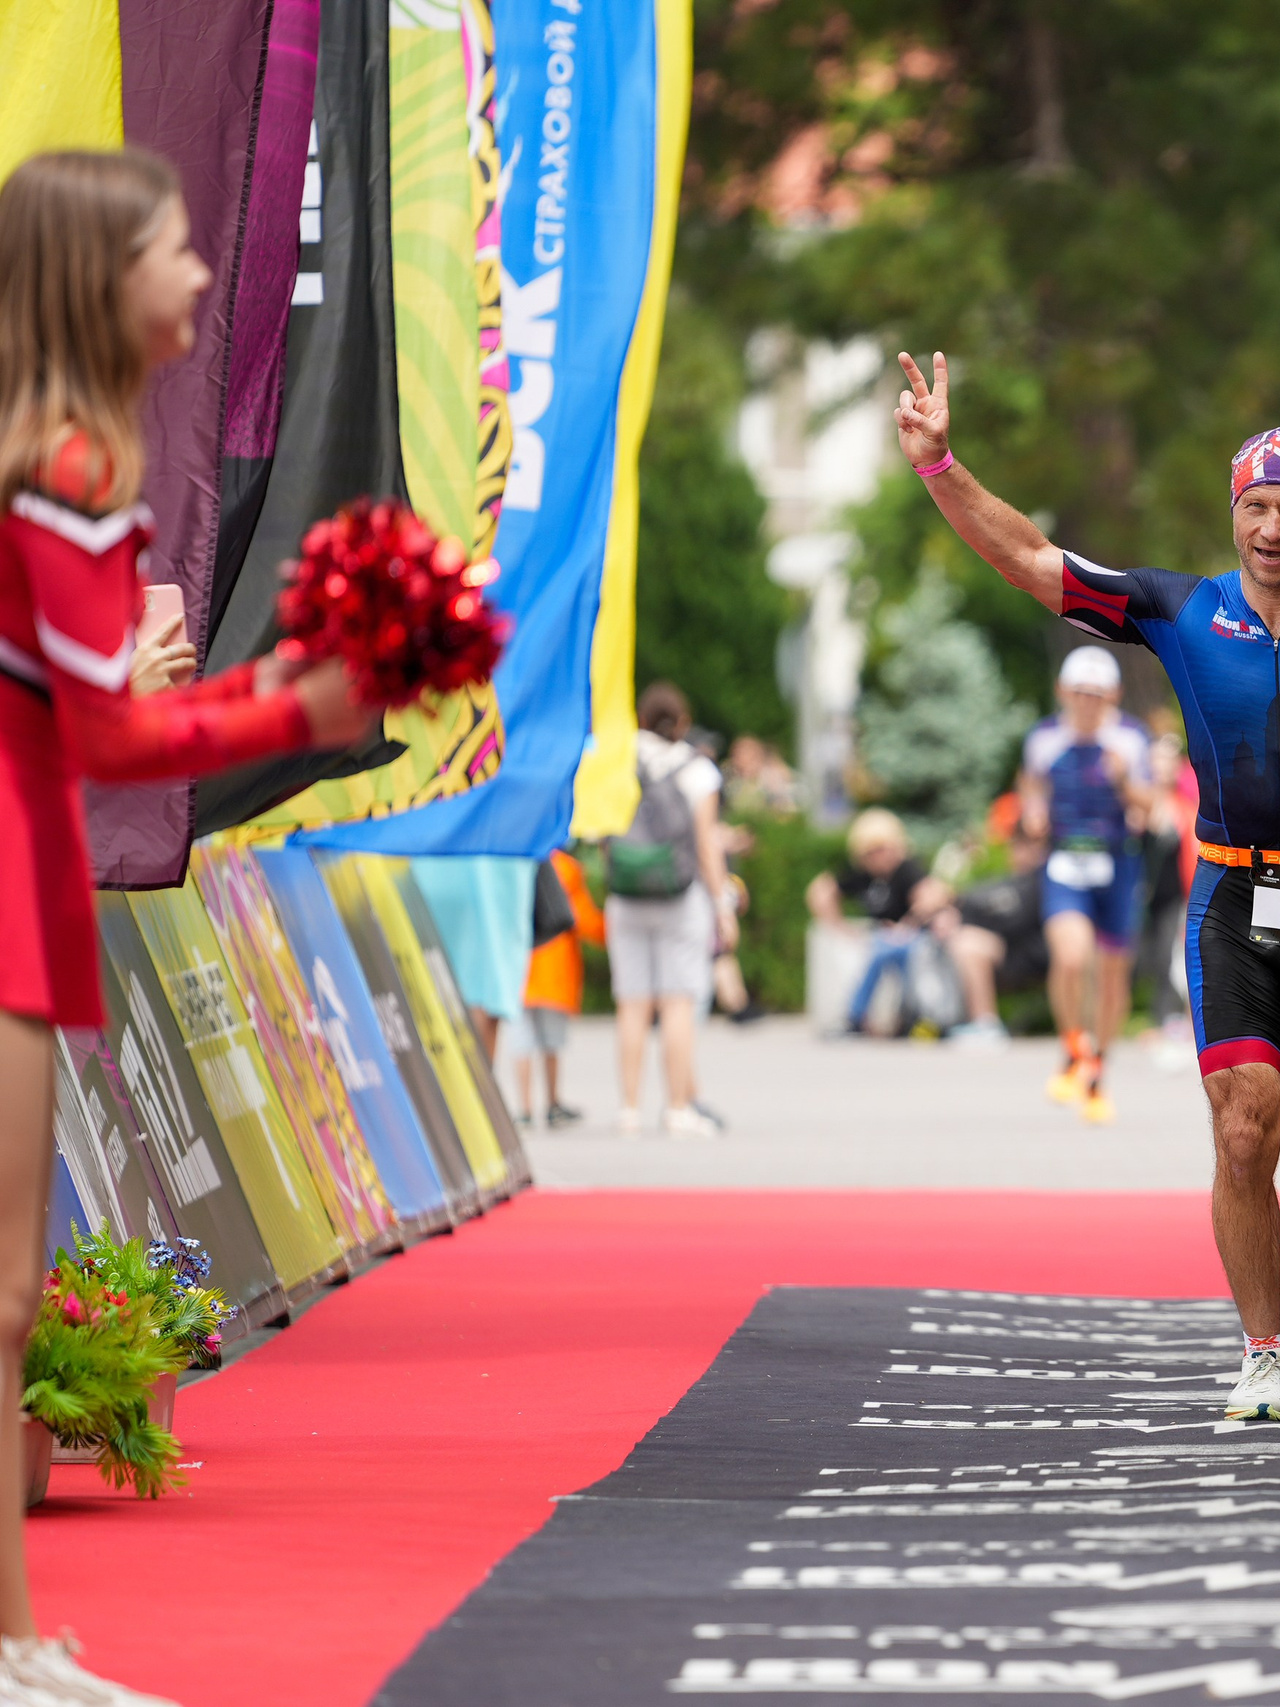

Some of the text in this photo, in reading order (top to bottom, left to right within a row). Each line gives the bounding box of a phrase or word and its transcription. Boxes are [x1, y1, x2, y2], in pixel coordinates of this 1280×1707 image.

[533, 20, 577, 265] СТРАХОВОЙ
[1210, 621, 1233, 639] 70.3
[1234, 631, 1258, 640] RUSSIA
